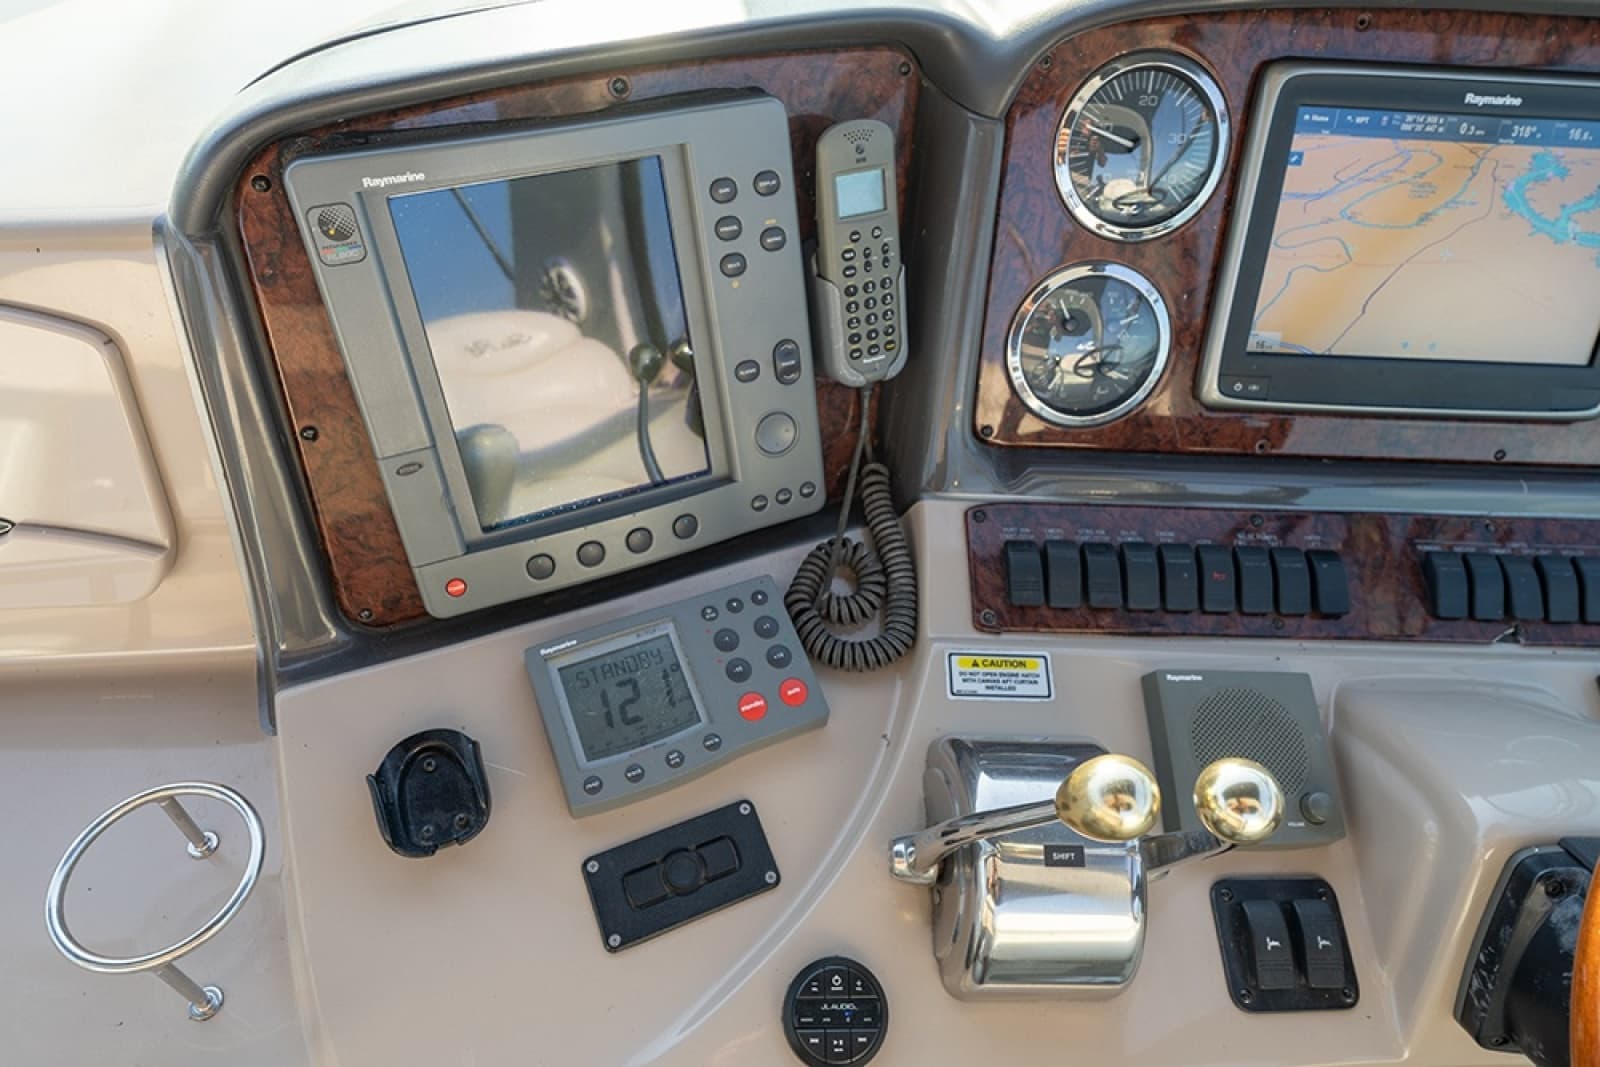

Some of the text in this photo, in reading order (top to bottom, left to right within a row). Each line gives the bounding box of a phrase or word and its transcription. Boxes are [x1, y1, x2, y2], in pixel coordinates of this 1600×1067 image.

[1138, 95, 1158, 106] 20
[1464, 92, 1522, 106] Raymarine
[361, 171, 426, 188] Raymarine
[575, 647, 665, 689] STANDBY
[982, 658, 1027, 668] CAUTION
[1052, 852, 1076, 860] SHIFT
